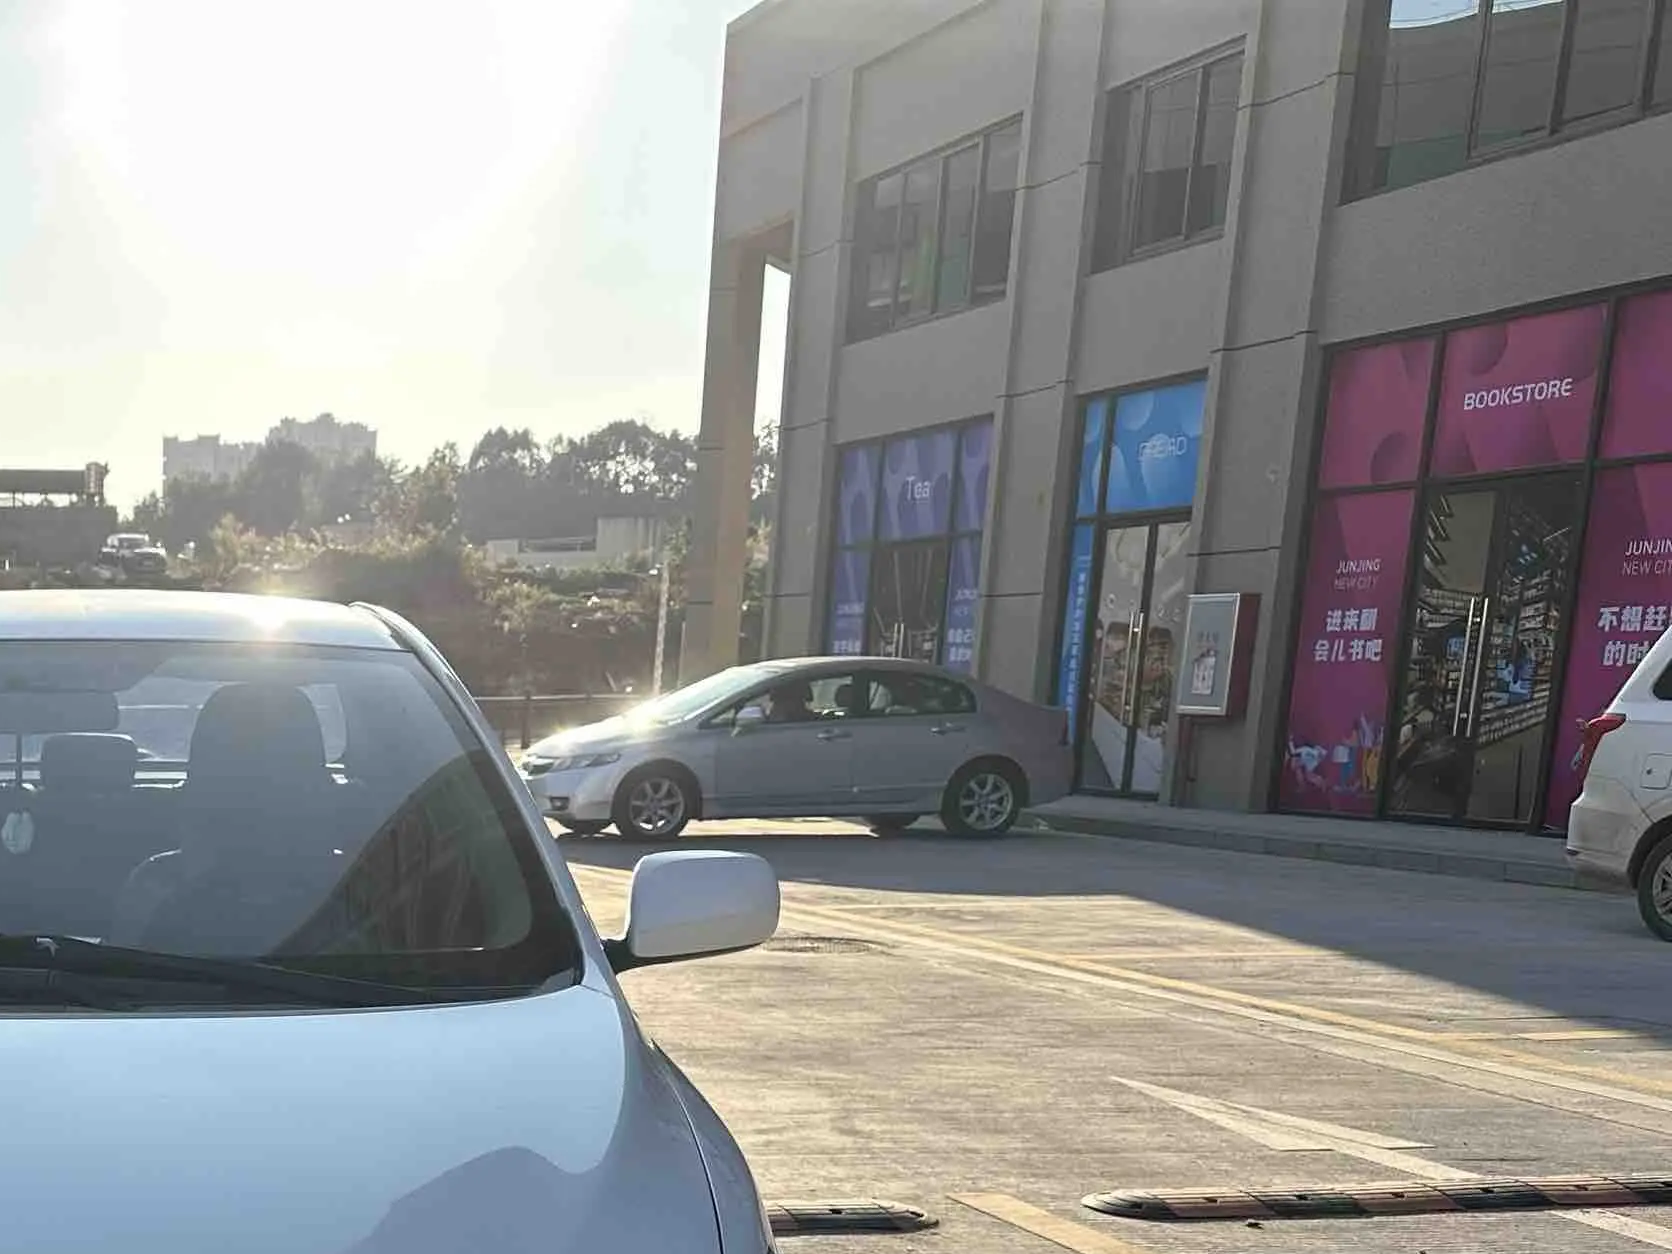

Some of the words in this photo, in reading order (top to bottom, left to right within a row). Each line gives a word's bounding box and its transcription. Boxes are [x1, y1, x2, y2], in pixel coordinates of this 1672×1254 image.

[1463, 378, 1573, 410] BOOKSTORE
[906, 476, 930, 500] Tea
[1336, 558, 1381, 574] JUNJING
[1622, 560, 1652, 577] NEW
[1597, 606, 1672, 632] 不想赶
[1313, 639, 1383, 661] 会儿书吧
